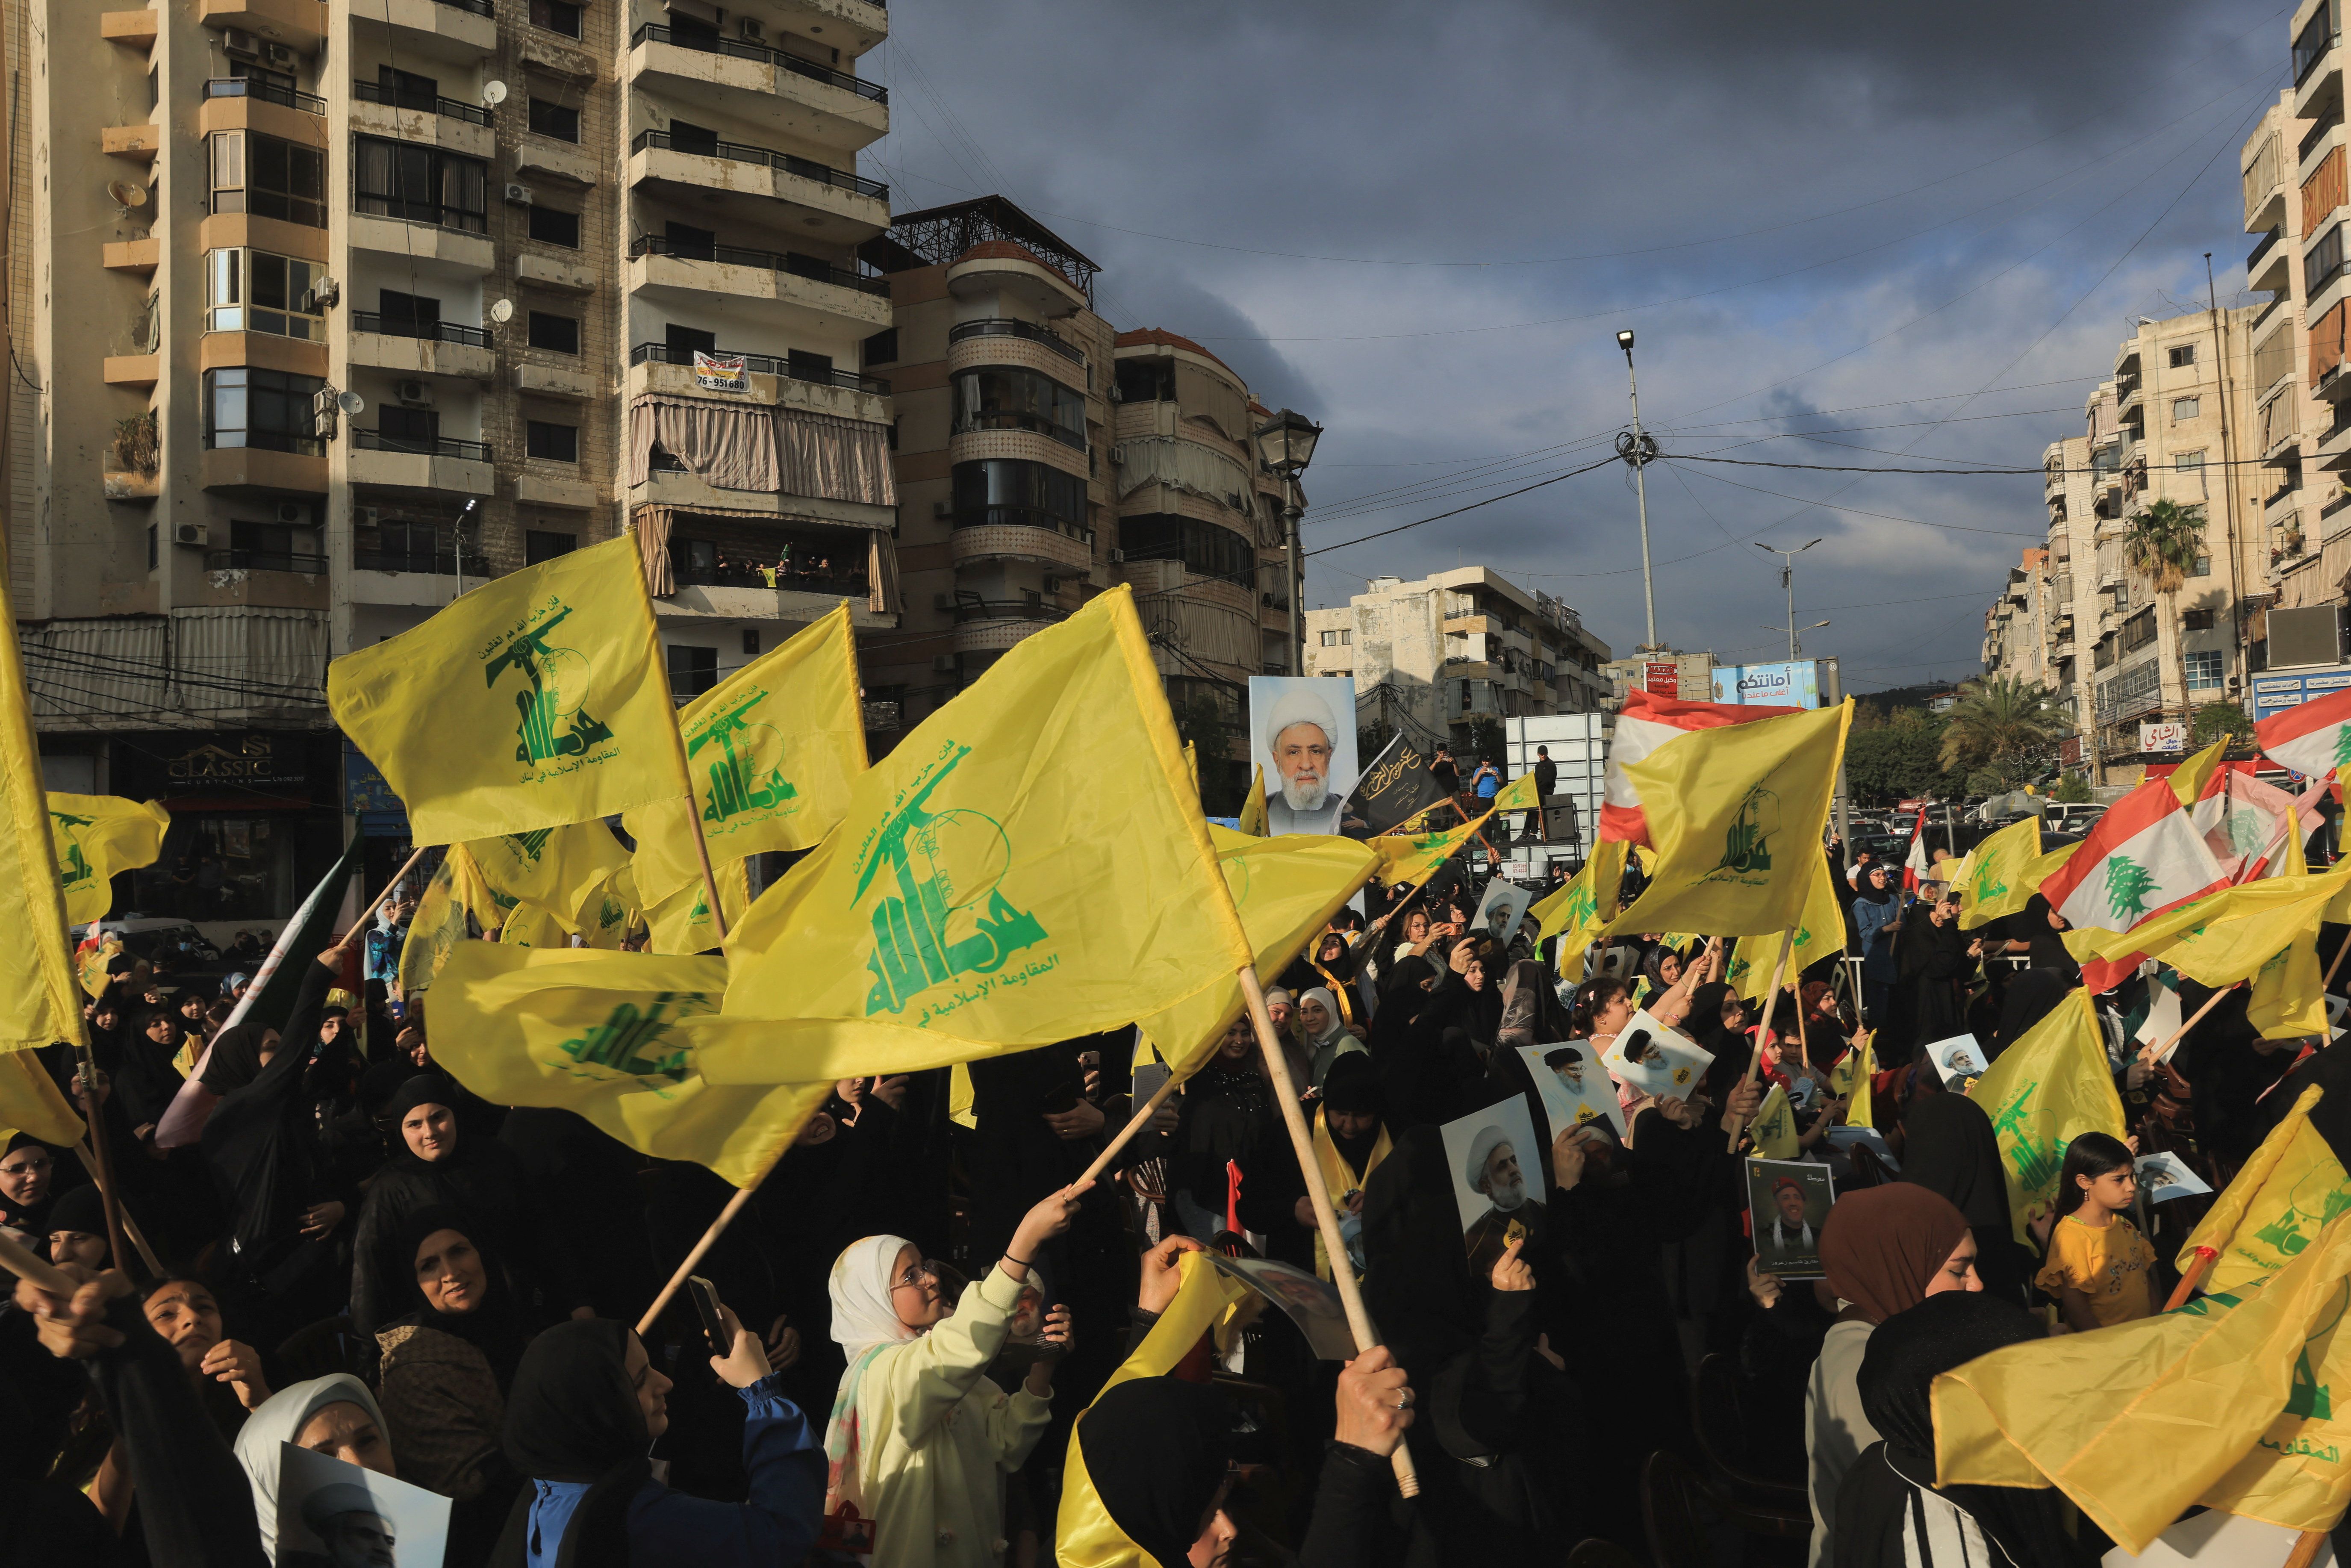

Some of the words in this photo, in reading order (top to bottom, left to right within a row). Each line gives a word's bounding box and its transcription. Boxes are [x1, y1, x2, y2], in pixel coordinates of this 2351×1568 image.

[698, 376, 707, 385] 76
[714, 378, 727, 387] 951
[729, 380, 744, 389] 680
[547, 595, 561, 611] فإن
[528, 609, 546, 623] حزب
[516, 619, 527, 632] الله
[506, 631, 514, 641] هم
[479, 636, 504, 660] الغالبون
[1648, 666, 1675, 674] MAXXIS
[1736, 666, 1791, 693] أمانتكم
[748, 685, 758, 695] فإن
[1770, 687, 1789, 696] أغلى
[730, 694, 746, 704] حزب
[719, 704, 728, 713] الله
[709, 712, 718, 721] هم
[684, 718, 707, 737] الغالبون
[2145, 725, 2178, 751] الشامي
[585, 748, 620, 765] المقاومة
[939, 739, 955, 760] فإن
[168, 749, 271, 777] CLASSIC
[547, 760, 584, 777] الإسلامية
[519, 771, 534, 784] لبنان
[536, 770, 546, 784] في
[910, 763, 934, 787] حزب
[895, 789, 907, 808] الله
[775, 805, 800, 818] المقاومة
[739, 813, 773, 826] الإسلامية
[881, 811, 891, 828] هم
[706, 827, 725, 838] لبنان
[727, 822, 739, 834] في
[852, 827, 877, 875] الغالبون
[999, 953, 1060, 987] المقاومة
[934, 979, 996, 1017] الإسلامية
[918, 1008, 931, 1028] في
